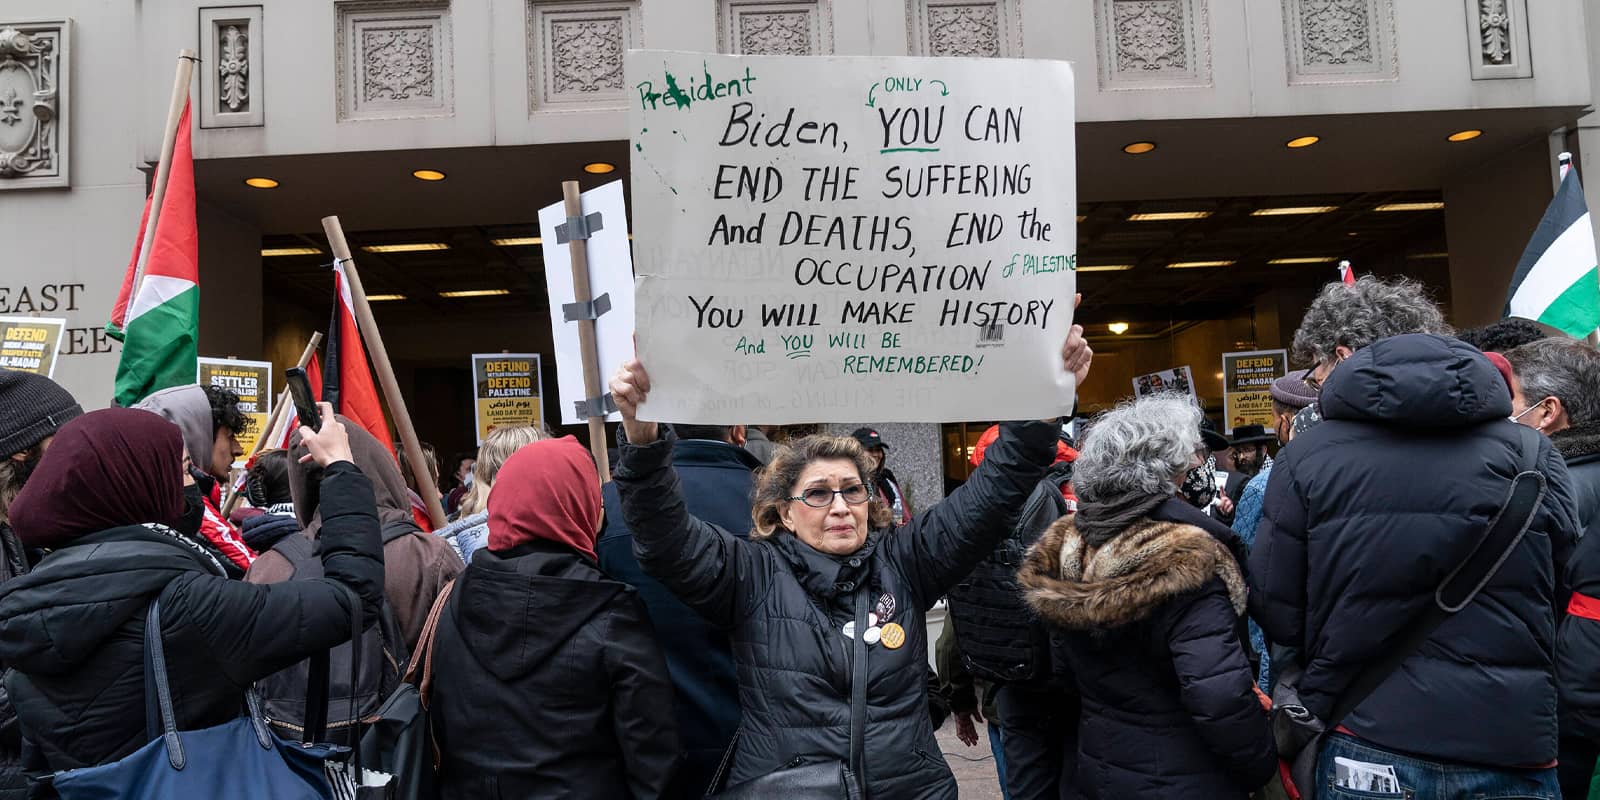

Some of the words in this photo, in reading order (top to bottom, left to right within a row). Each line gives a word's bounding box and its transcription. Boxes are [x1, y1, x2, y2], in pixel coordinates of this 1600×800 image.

[885, 77, 922, 92] ONLY
[718, 101, 848, 153] Biden,
[879, 106, 945, 148] YOU
[964, 105, 1023, 143] CAN
[713, 164, 783, 203] END
[802, 166, 860, 202] THE
[881, 163, 1032, 198] SUFFERING
[707, 212, 767, 246] And
[778, 210, 916, 258] DEATHS,
[945, 212, 1004, 249] END
[1017, 207, 1052, 242] the
[1002, 253, 1020, 279] of
[1022, 253, 1077, 276] PALESTINE
[794, 257, 992, 294] OCCUPATION
[0, 284, 85, 313] EAST
[761, 303, 821, 328] WILL
[841, 300, 916, 325] MAKE
[939, 299, 1054, 330] HISTORY
[6, 327, 48, 342] DEFEND
[735, 336, 766, 356] And
[781, 334, 814, 350] YOU
[881, 331, 901, 349] BE
[486, 361, 530, 372] DEFUND
[843, 354, 985, 375] REMEMBERED!
[1236, 358, 1274, 368] DEFEND
[211, 376, 258, 388] SETTLER
[488, 377, 531, 388] DEFEND
[1237, 378, 1274, 386] AL-NAQAB
[488, 388, 532, 397] PALESTINE
[236, 402, 257, 412] CIDE
